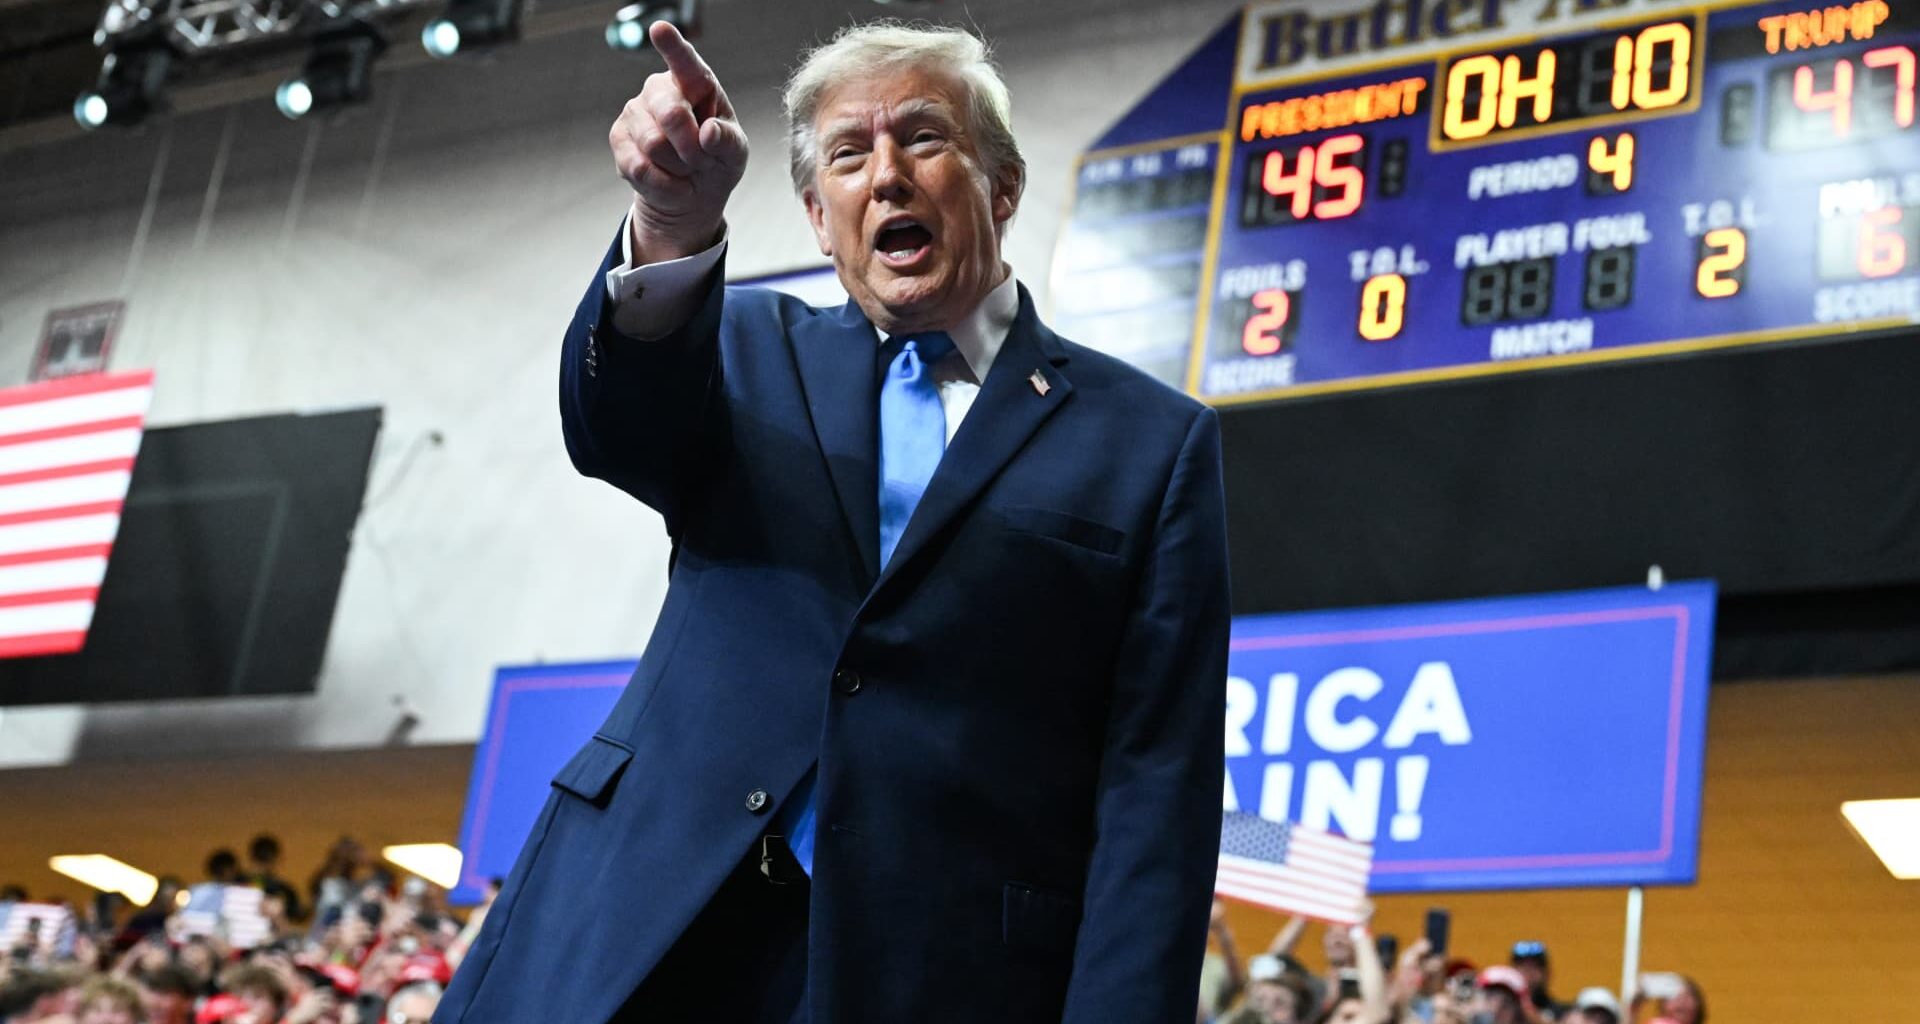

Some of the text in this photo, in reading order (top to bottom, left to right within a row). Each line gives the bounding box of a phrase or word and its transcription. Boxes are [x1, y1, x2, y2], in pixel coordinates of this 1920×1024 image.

[1758, 0, 1889, 54] TRUMP
[1611, 22, 1691, 110] 10
[1794, 46, 1916, 138] 47
[1241, 77, 1427, 142] PRESIDENT
[1263, 133, 1364, 220] 45
[1468, 154, 1579, 200] PERIOD
[1588, 133, 1634, 191] 4
[1454, 211, 1652, 268] PLAYER FOUL
[1696, 228, 1746, 298] 2
[1856, 205, 1906, 279] 6
[1220, 259, 1307, 299] FOULS
[1358, 273, 1406, 341] 0
[1243, 288, 1290, 356] 2
[1490, 317, 1594, 360] MATCH
